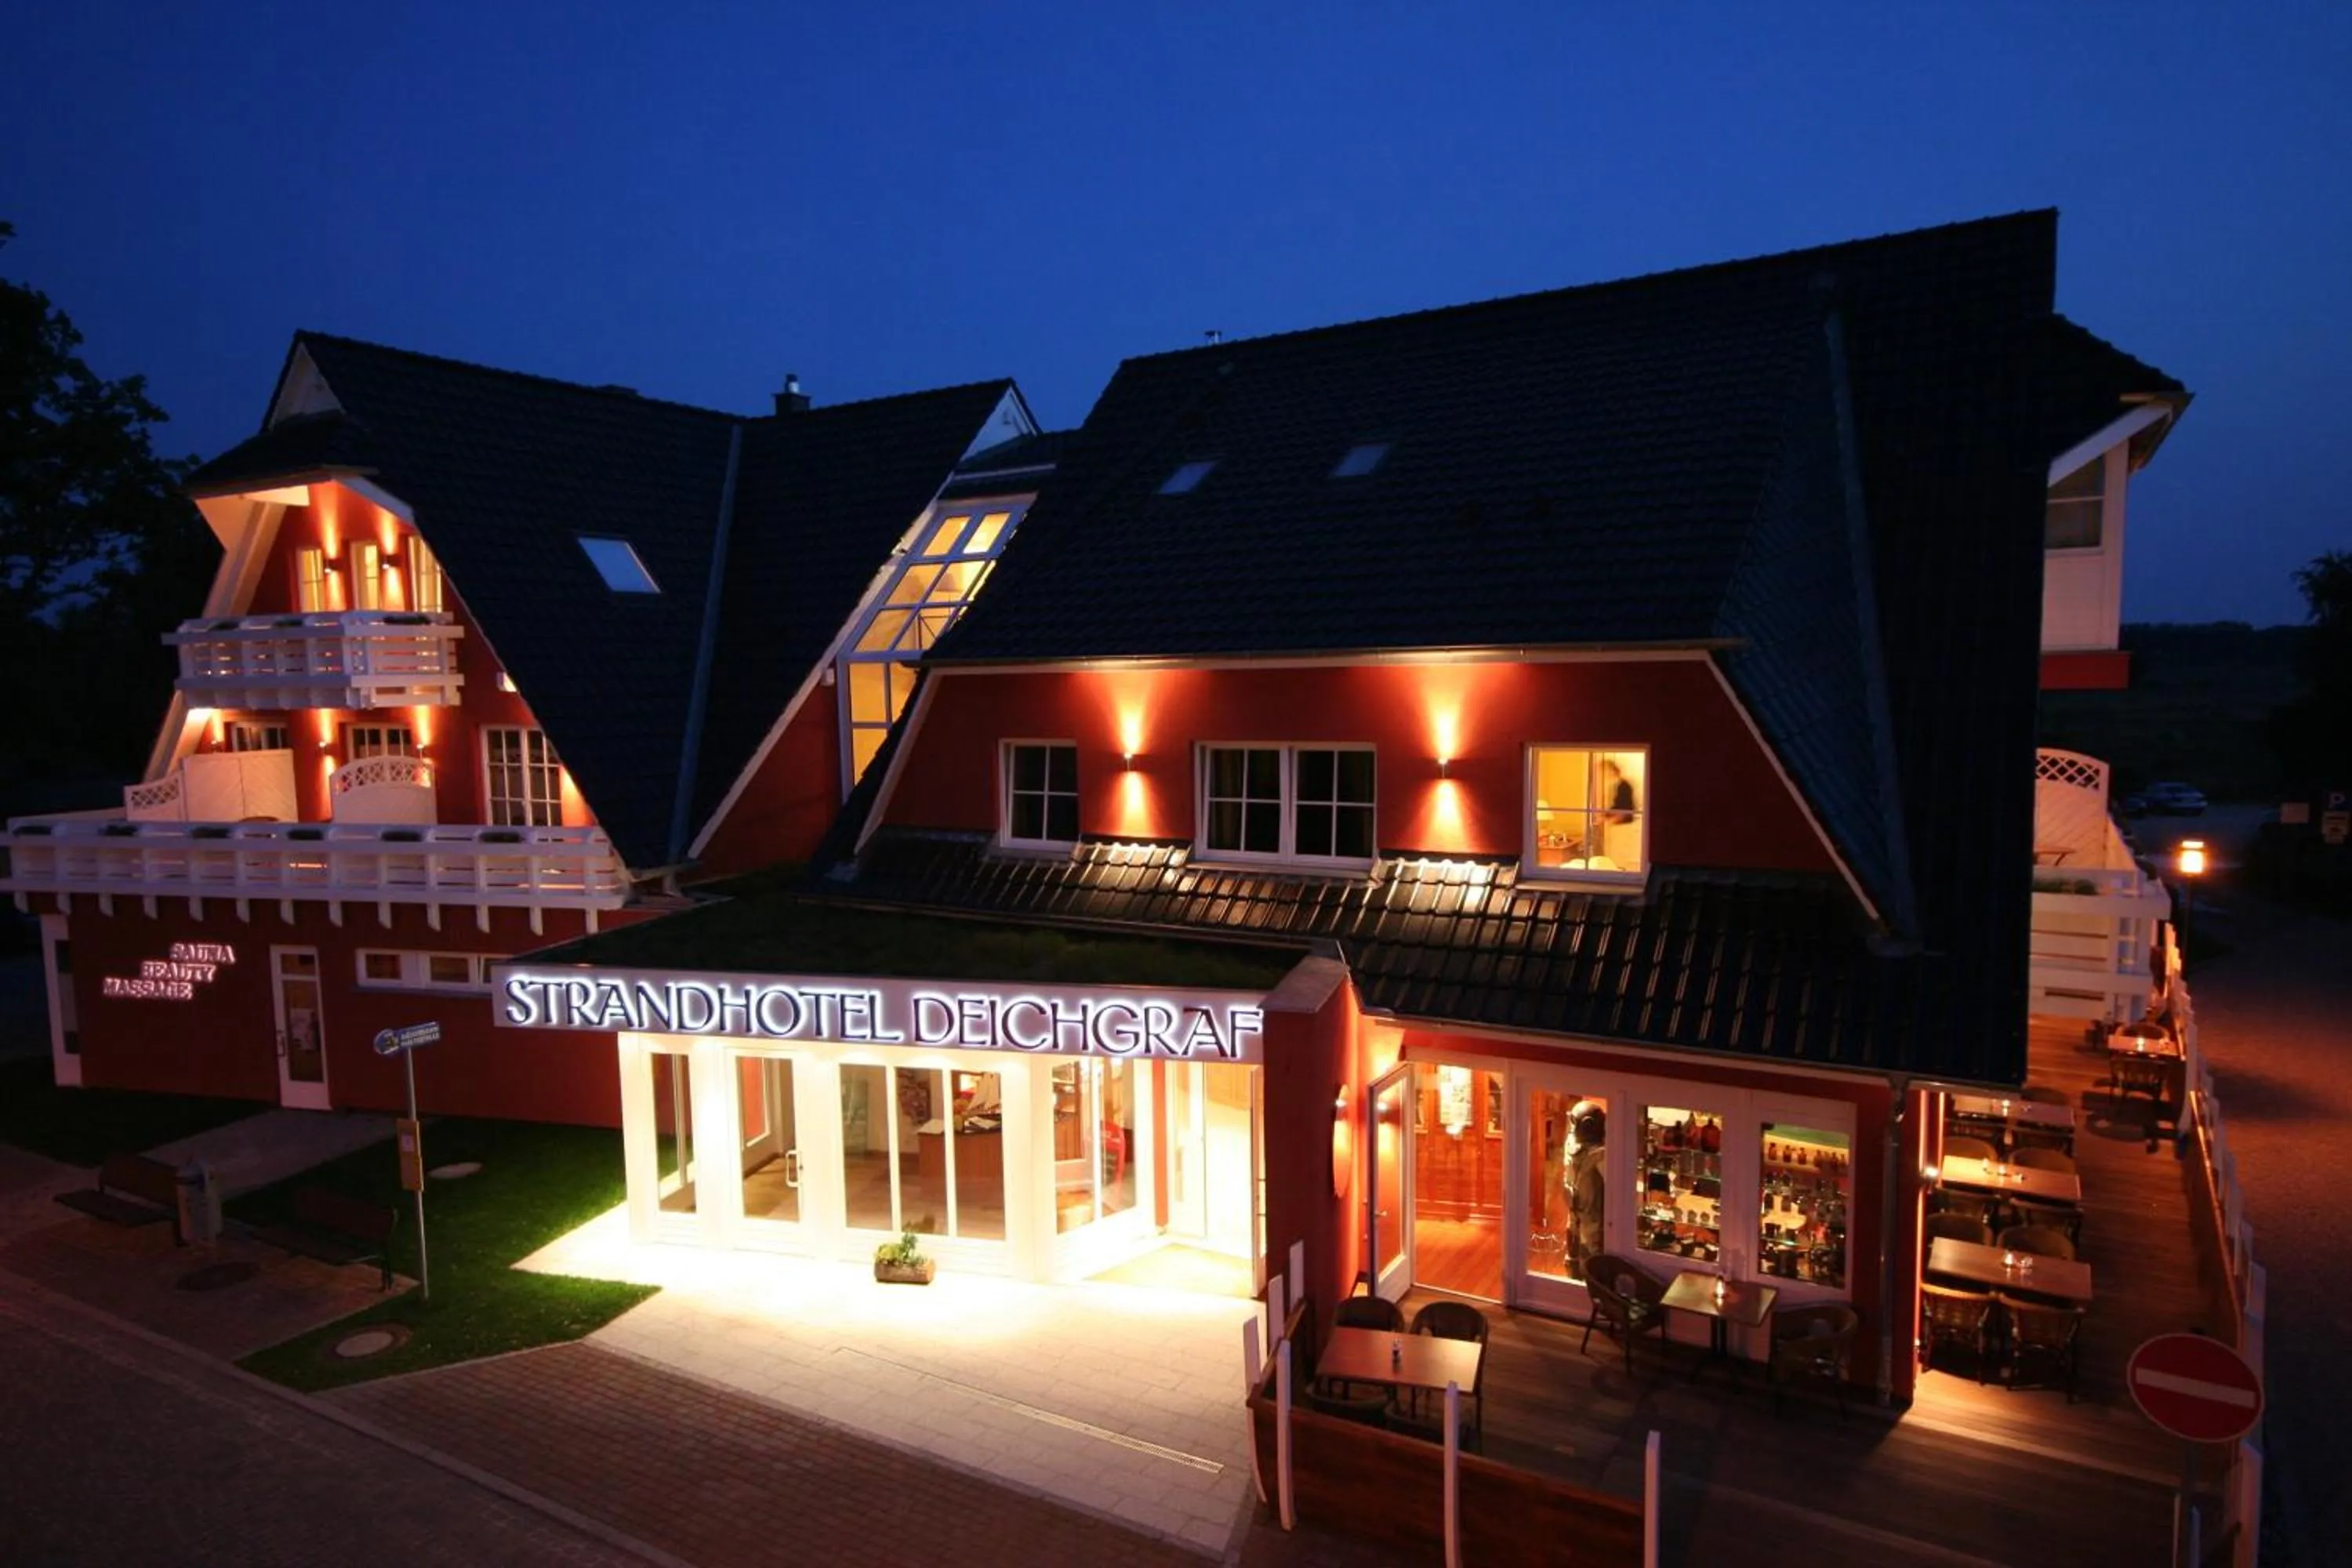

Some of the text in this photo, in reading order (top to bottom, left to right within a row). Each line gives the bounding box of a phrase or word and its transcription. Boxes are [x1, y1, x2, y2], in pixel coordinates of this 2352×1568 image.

[2328, 791, 2346, 809] P
[170, 943, 235, 964] SAUNA
[142, 961, 216, 982] BEAUTY
[103, 978, 193, 1000] MASSAGE
[504, 976, 1264, 1058] STRANDHOTEL DEICHGRAF
